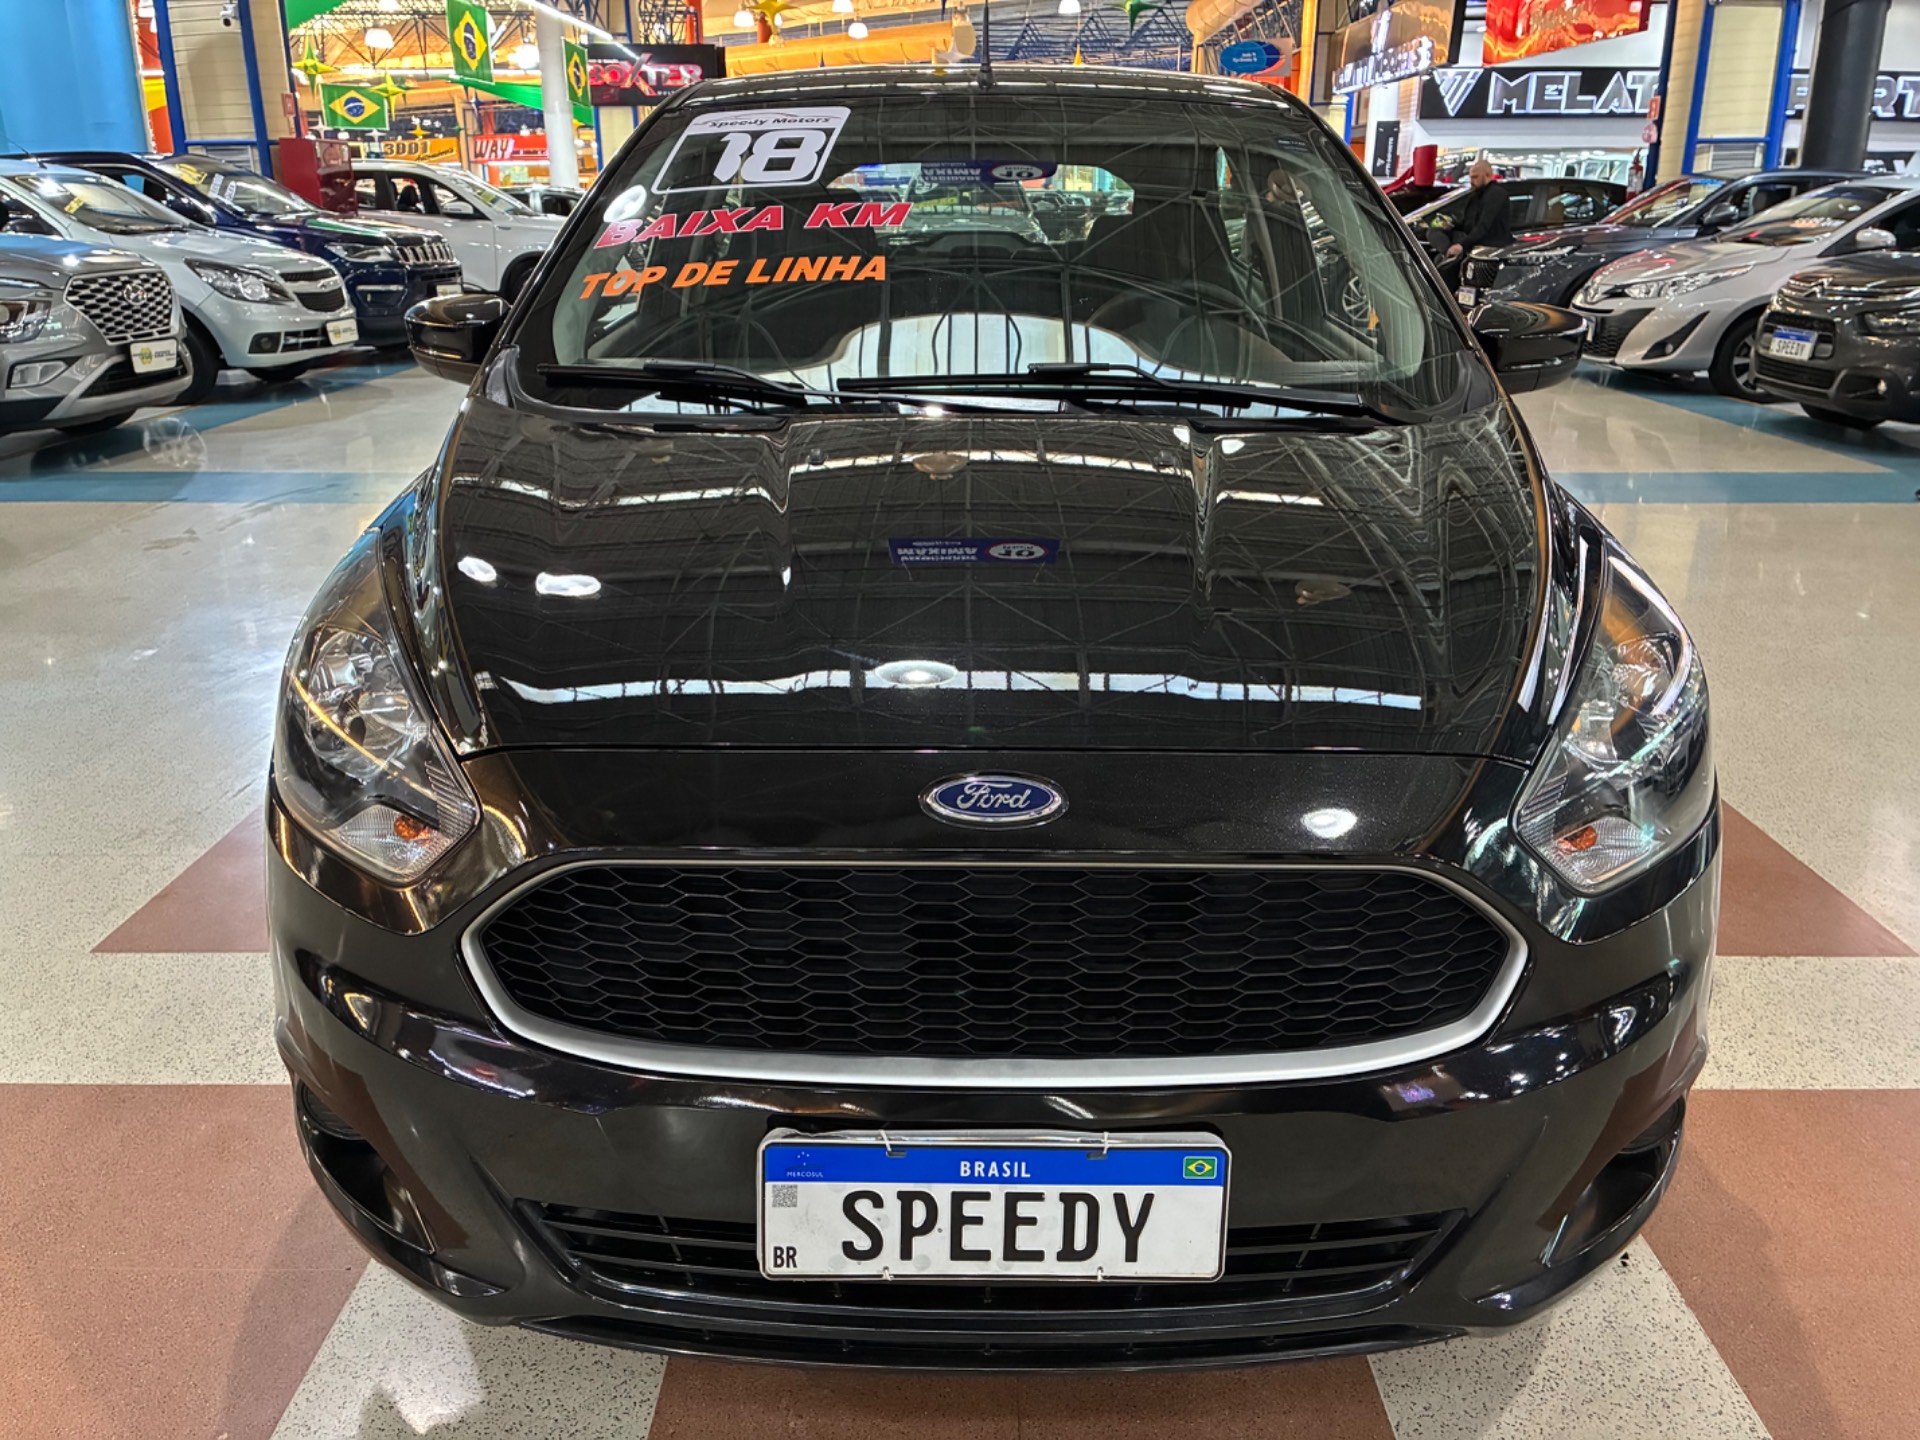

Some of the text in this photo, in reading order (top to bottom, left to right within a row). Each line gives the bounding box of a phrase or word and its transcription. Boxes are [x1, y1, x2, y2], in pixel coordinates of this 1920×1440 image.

[588, 53, 703, 96] BOXTER
[473, 138, 512, 159] WAY
[713, 129, 828, 183] 18
[593, 202, 914, 249] BAIXA KM
[579, 255, 886, 299] TOP DE LINHA
[1776, 339, 1807, 356] SPEEDY
[957, 782, 1032, 809] Ford
[959, 1160, 1032, 1178] BRASIL
[842, 1189, 1155, 1263] SPEEDY
[772, 1246, 798, 1269] BR
